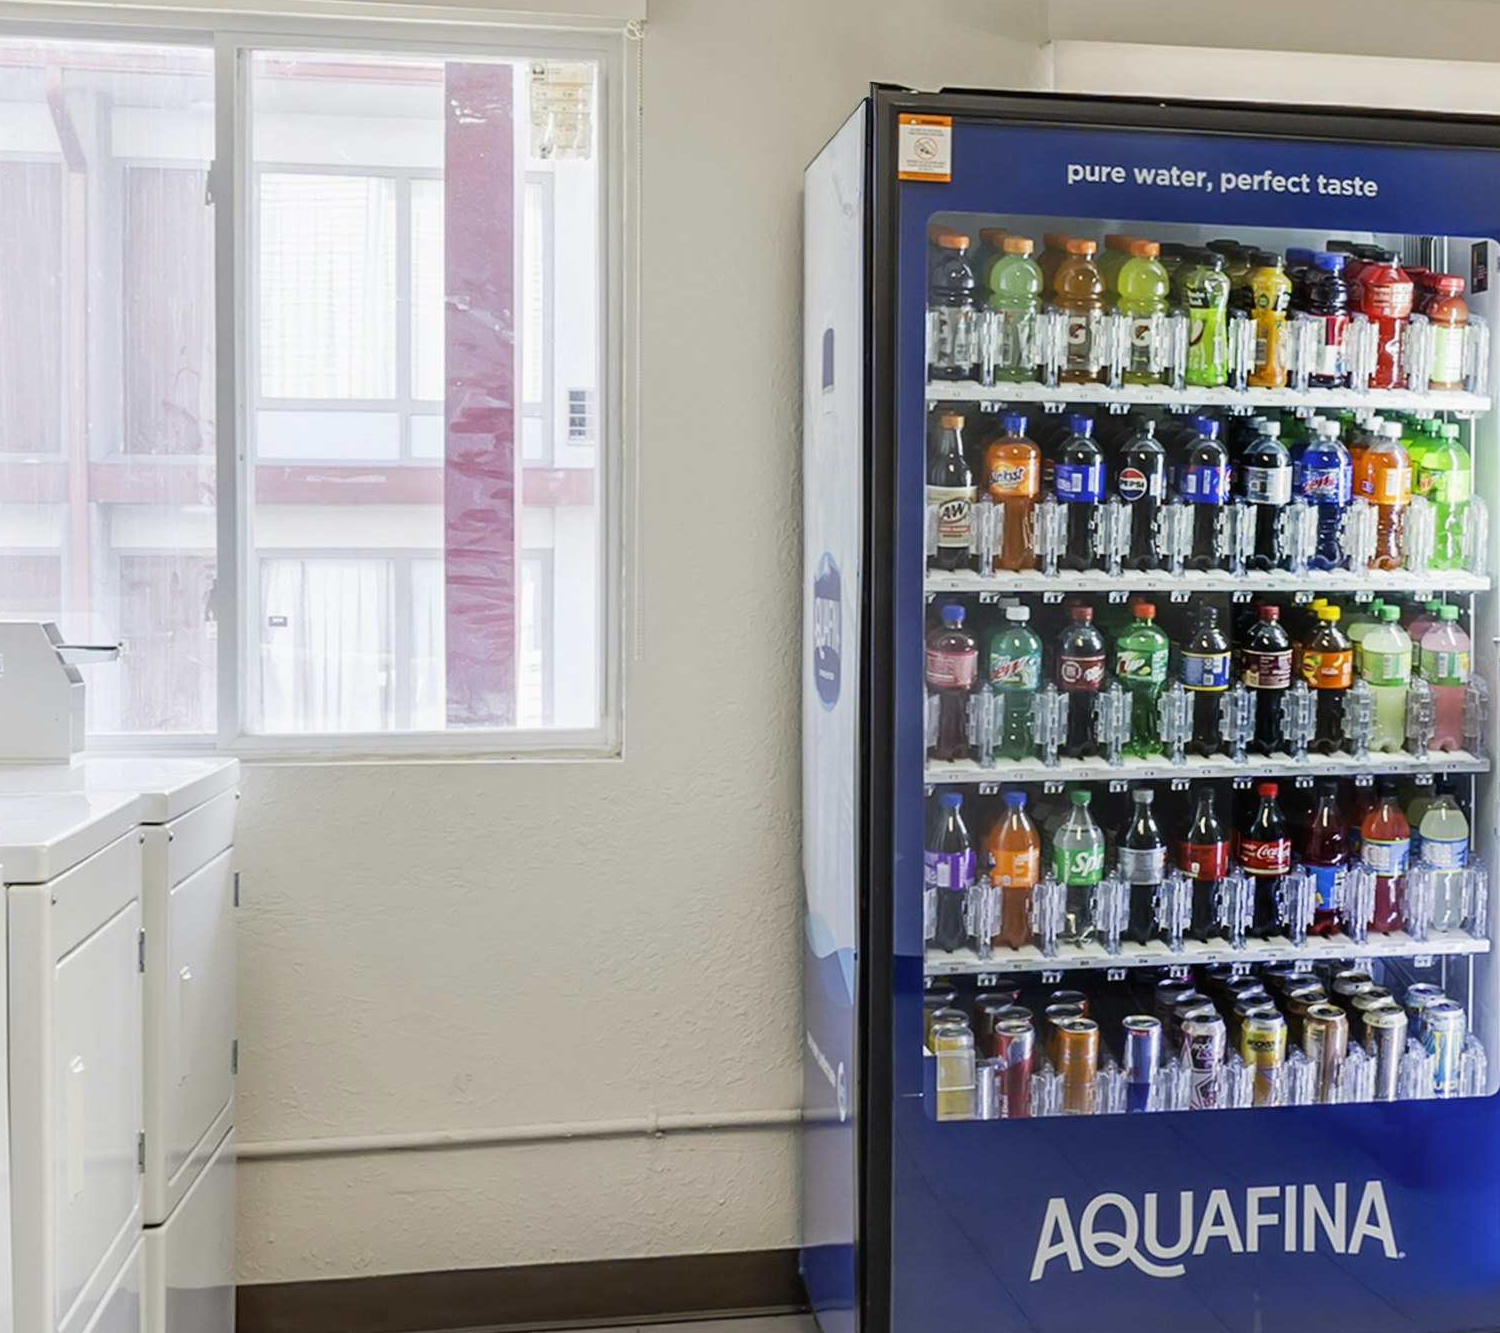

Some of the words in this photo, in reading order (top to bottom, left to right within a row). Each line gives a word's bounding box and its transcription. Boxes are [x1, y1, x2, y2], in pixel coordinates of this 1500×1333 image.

[1067, 164, 1127, 185] pure
[1133, 166, 1214, 193] water,
[1220, 170, 1311, 194] perfect
[1317, 174, 1379, 198] taste
[1119, 477, 1147, 490] PEPSI
[1029, 1179, 1405, 1282] AQUAFINA
